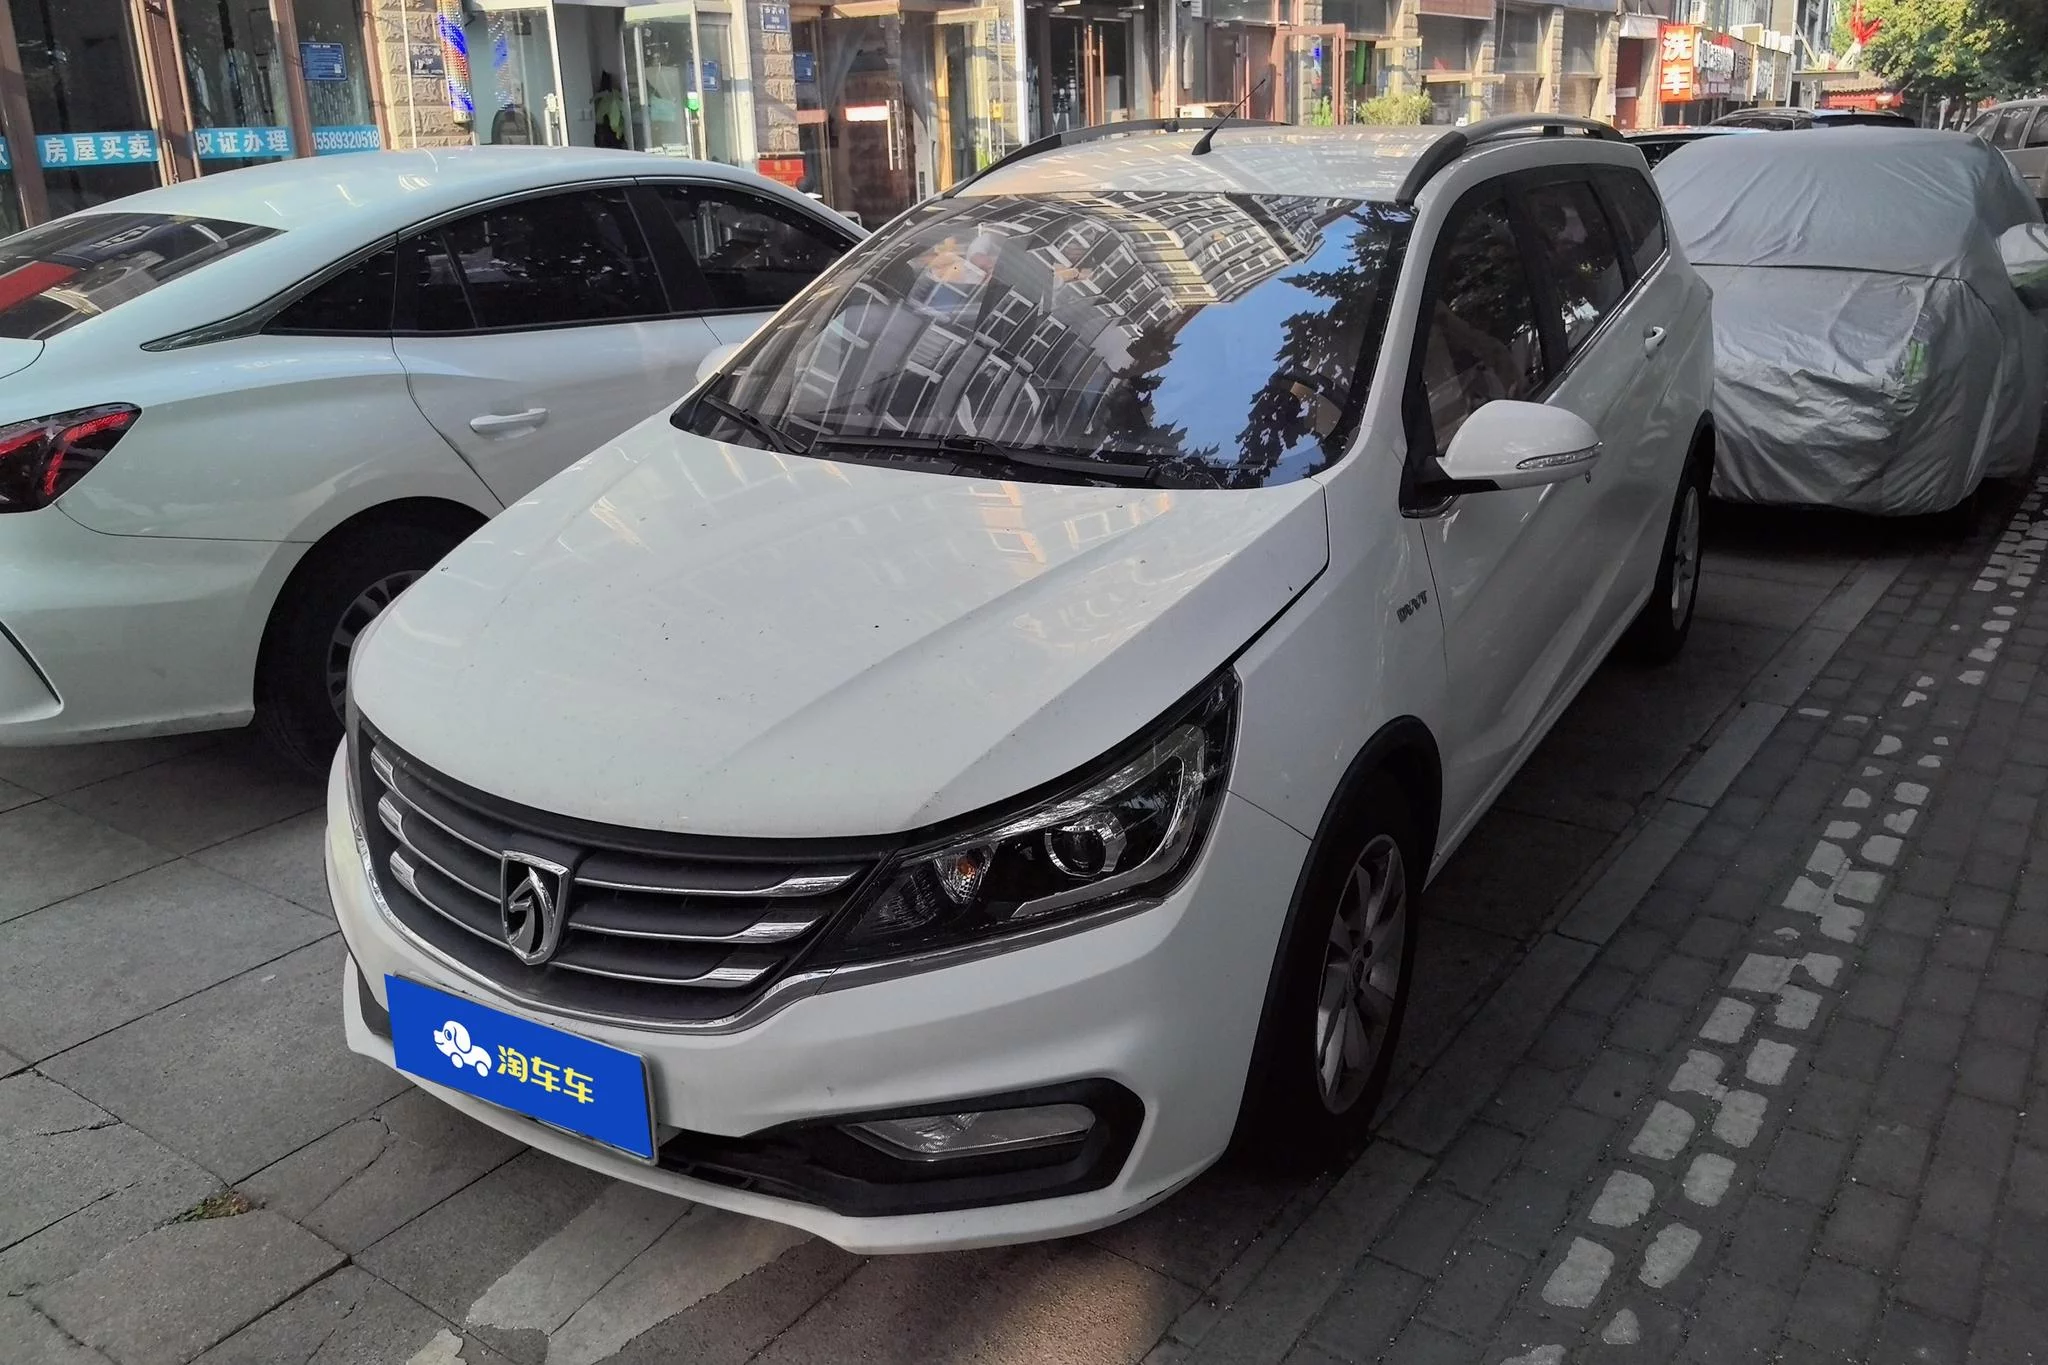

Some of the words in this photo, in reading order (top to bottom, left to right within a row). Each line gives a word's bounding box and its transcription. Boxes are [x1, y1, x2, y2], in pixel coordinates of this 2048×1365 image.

[1660, 28, 1693, 96] 洗车
[43, 133, 153, 163] 房屋买卖
